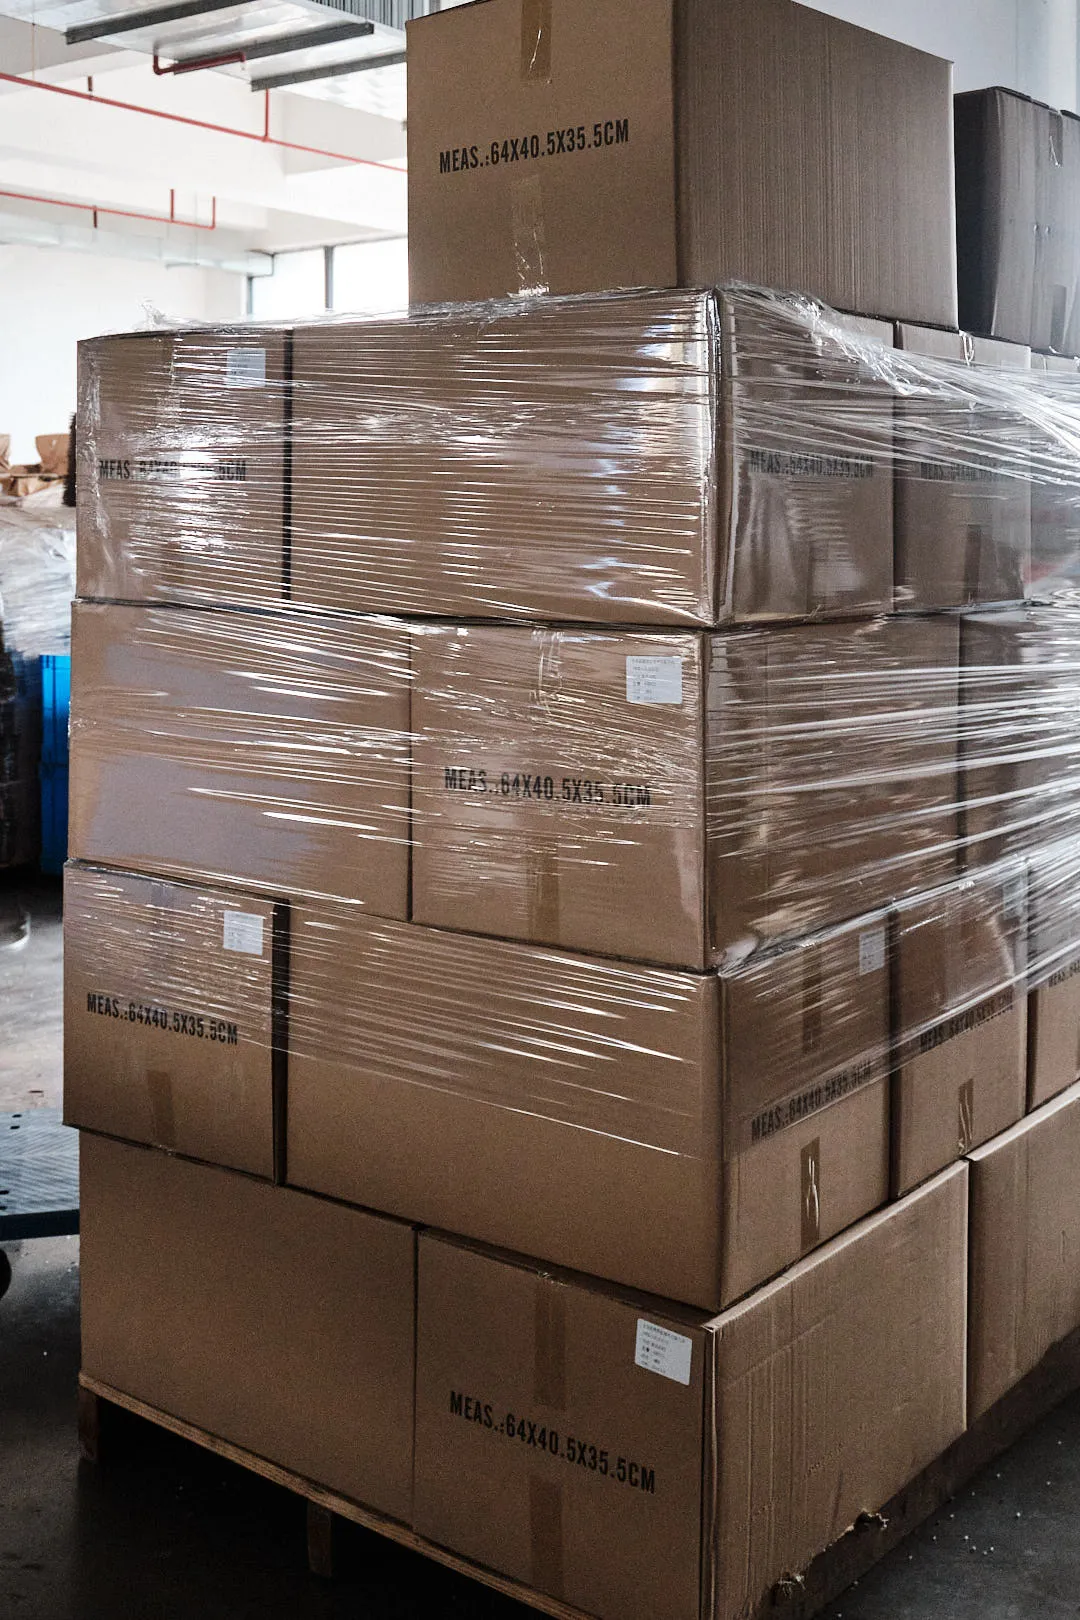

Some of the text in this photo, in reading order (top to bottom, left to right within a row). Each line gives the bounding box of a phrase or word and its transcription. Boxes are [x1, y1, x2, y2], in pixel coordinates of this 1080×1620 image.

[439, 118, 630, 174] MEAS.:64X40.5X35.5CM
[86, 992, 239, 1046] MEAS.:64X40.5X35.5CM
[449, 1390, 655, 1494] MEAS.:64X40.5X35.5CM
